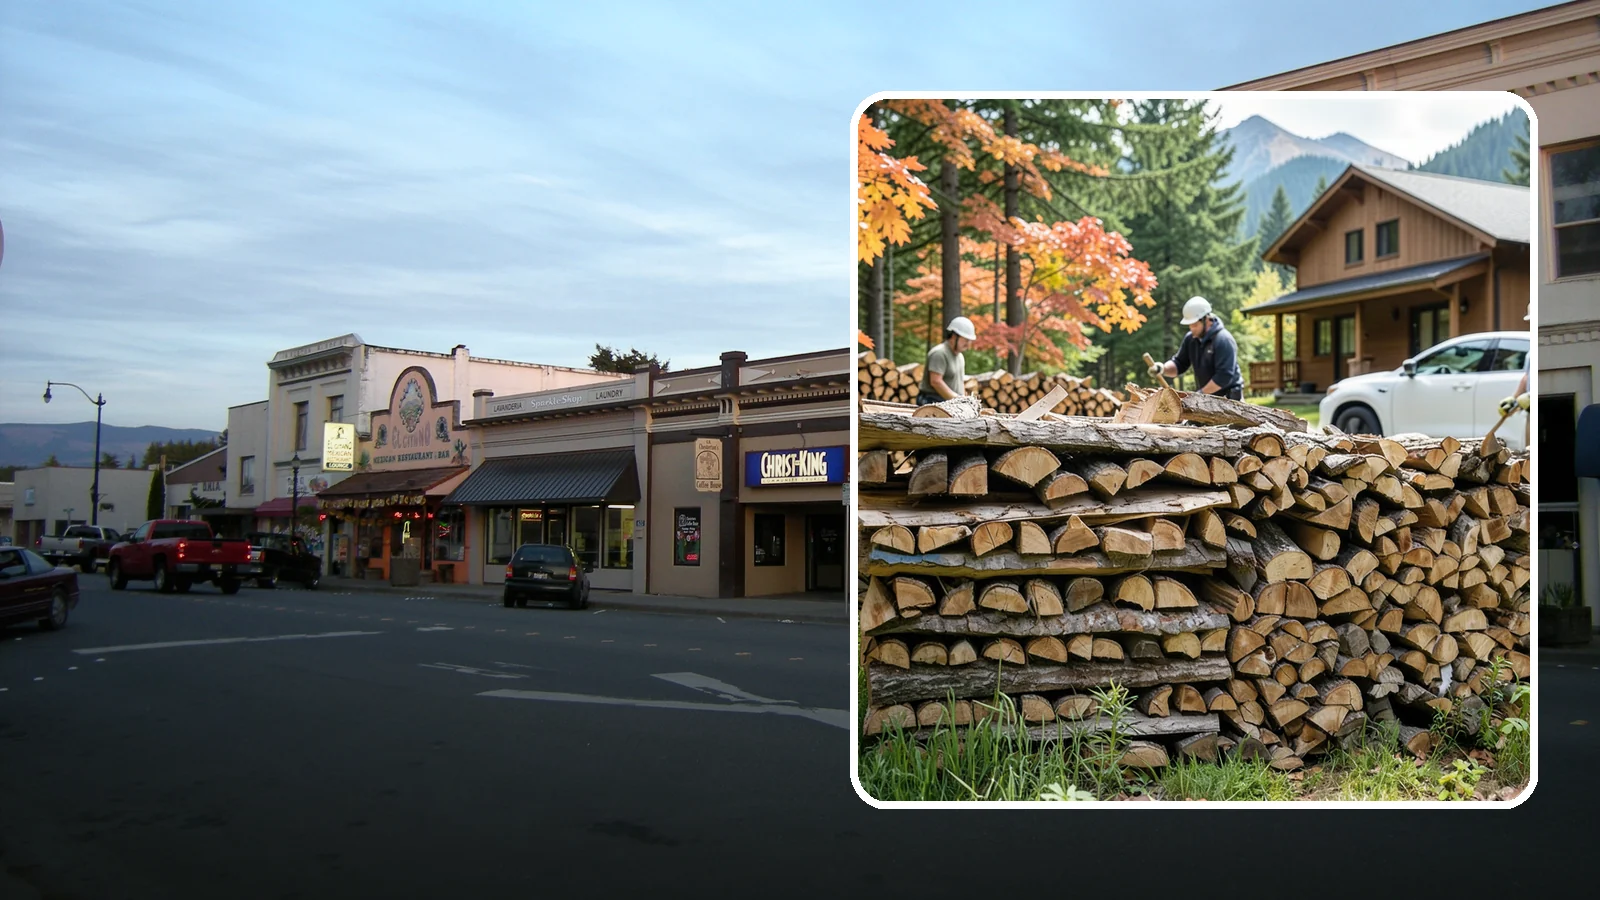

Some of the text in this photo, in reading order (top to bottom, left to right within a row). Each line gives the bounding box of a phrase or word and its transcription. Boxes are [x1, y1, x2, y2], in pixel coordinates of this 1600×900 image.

[493, 402, 522, 412] LAVANDERIA
[561, 394, 582, 403] Shop
[595, 389, 623, 400] LAUNDRY
[373, 454, 397, 464] MEXICAN
[397, 451, 433, 463] RESTAURANT
[438, 450, 450, 459] BAR
[761, 450, 827, 477] CHRIST KING
